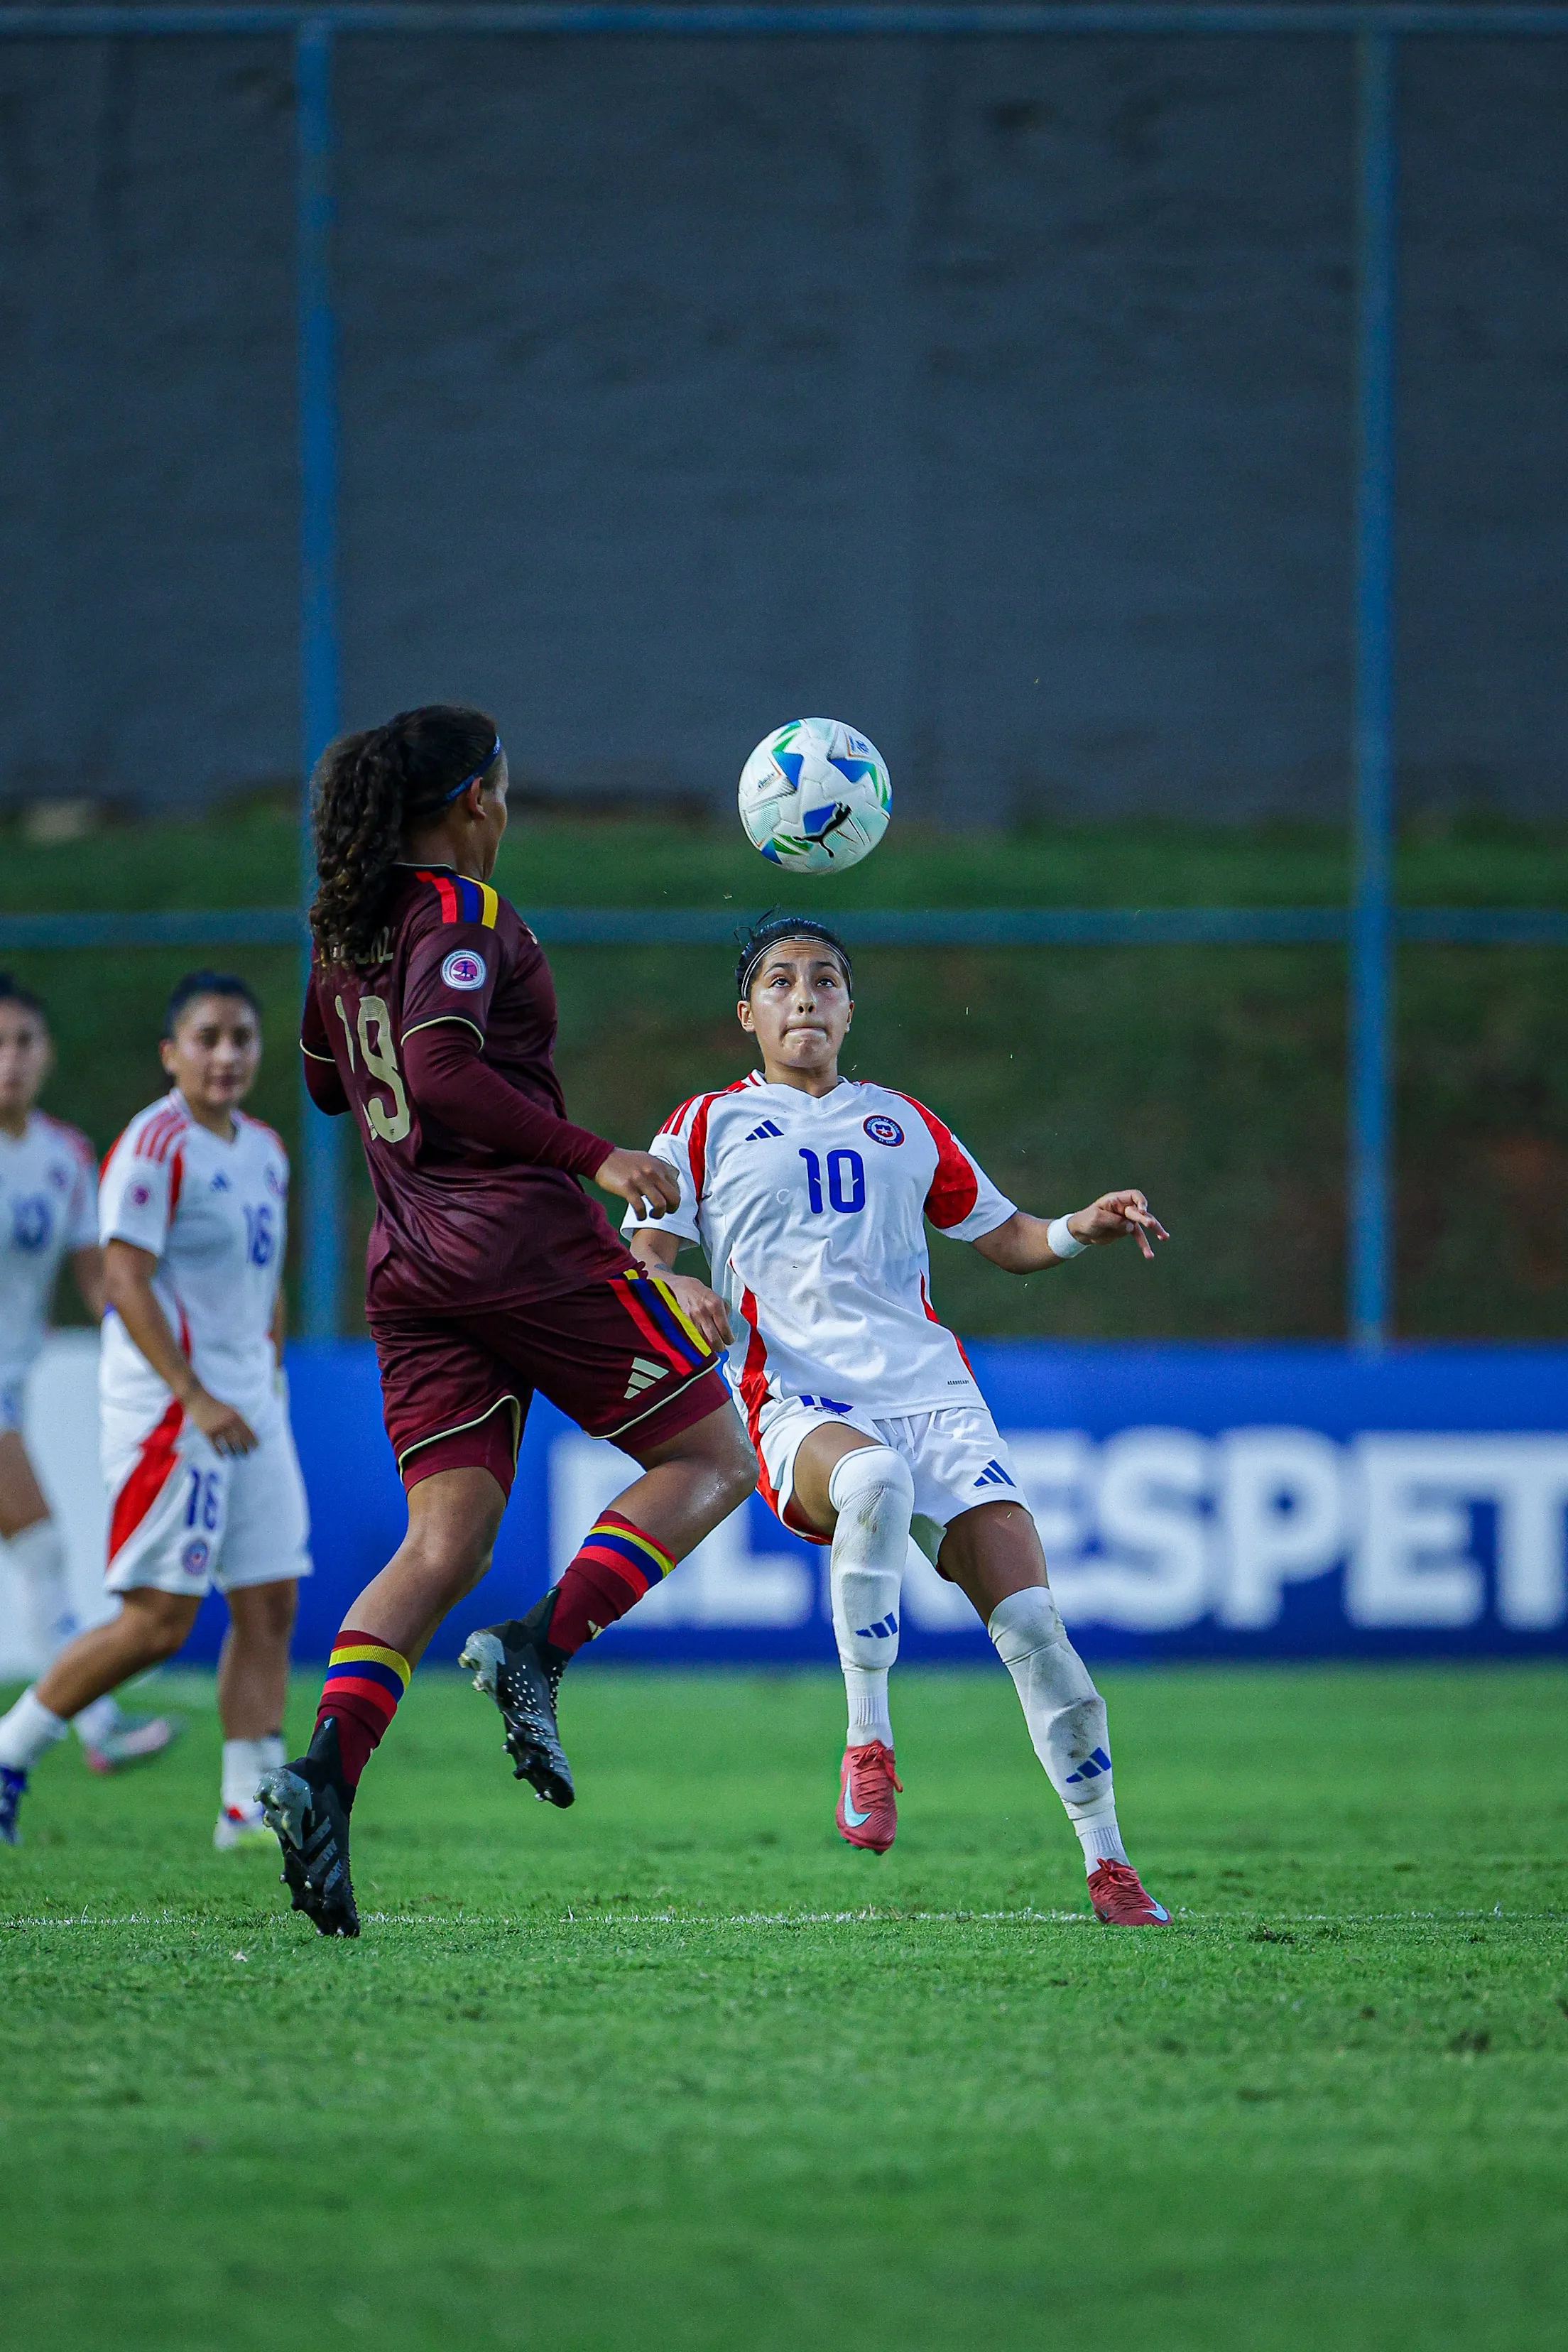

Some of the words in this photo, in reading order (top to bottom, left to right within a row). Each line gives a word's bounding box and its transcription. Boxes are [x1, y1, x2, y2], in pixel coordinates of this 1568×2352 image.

[334, 995, 410, 1143] 19
[797, 1147, 866, 1214] 10
[242, 1202, 274, 1268] 16
[185, 1467, 219, 1531] 16
